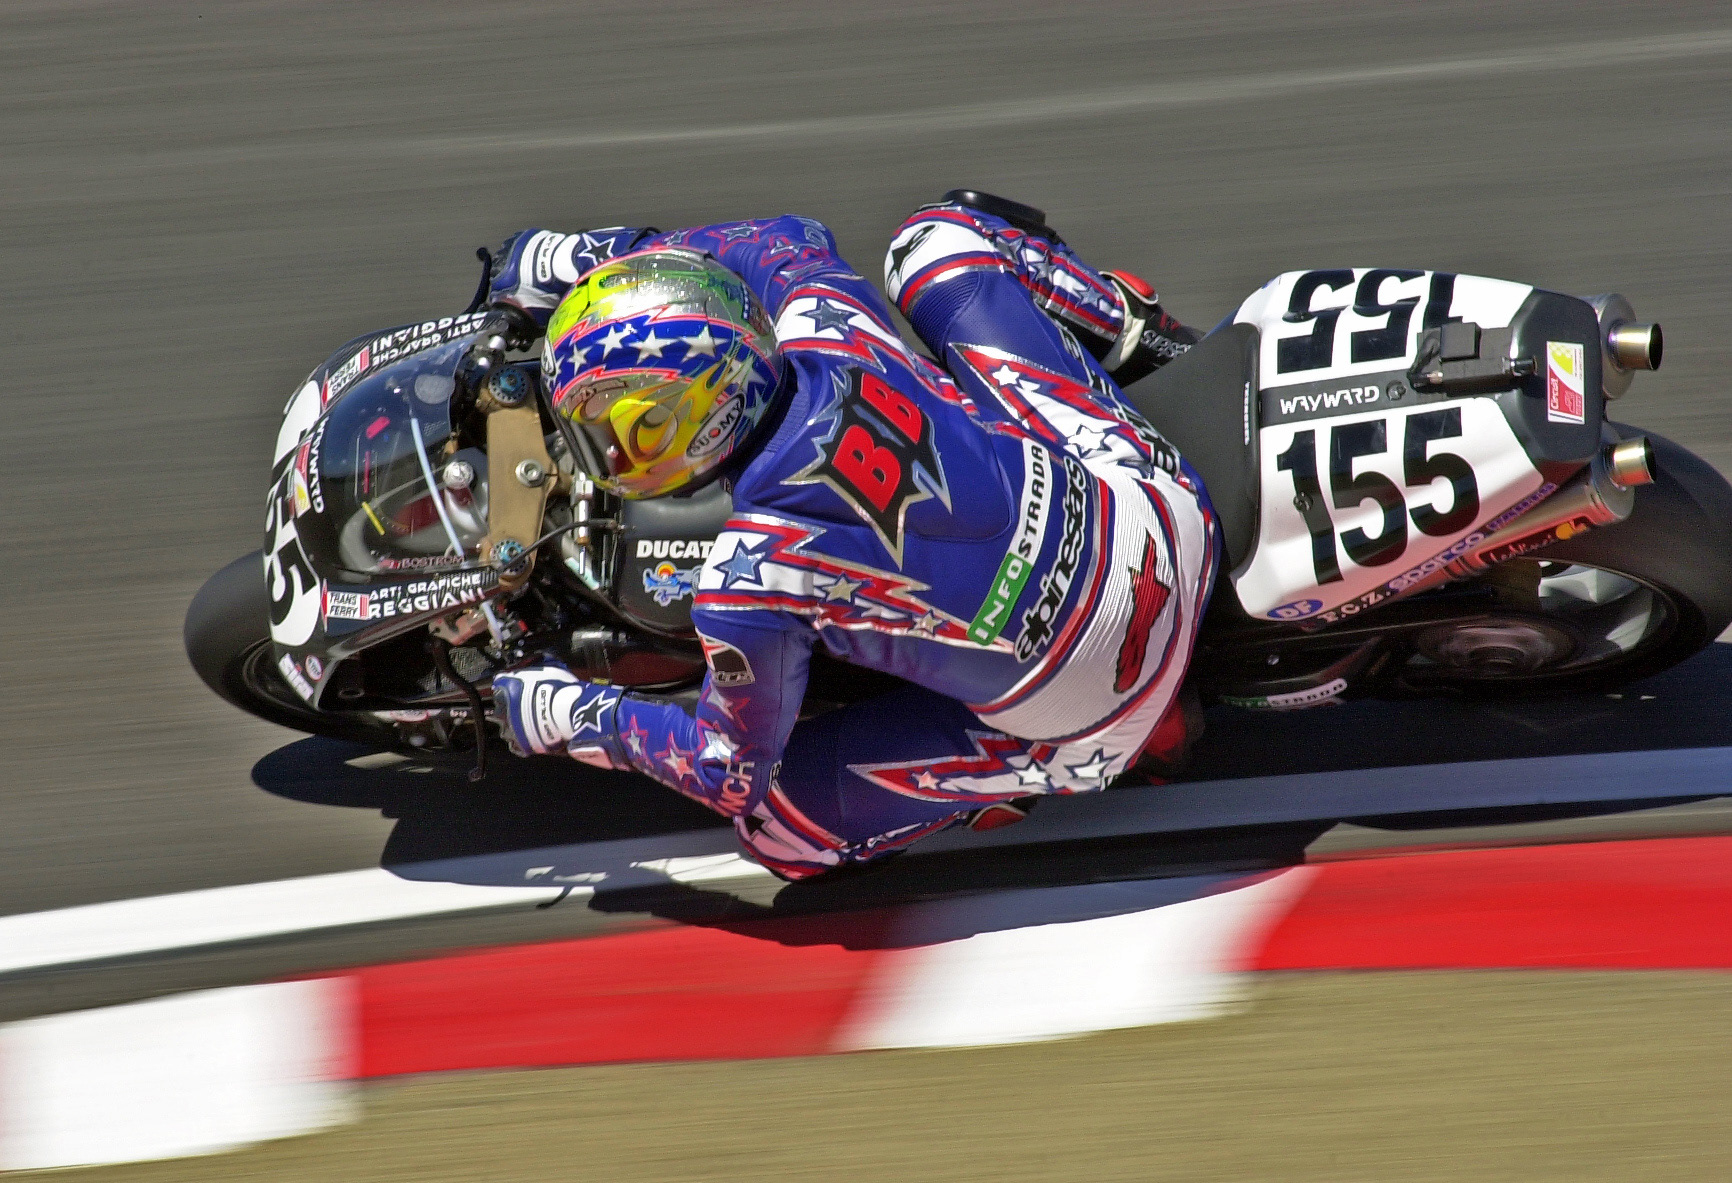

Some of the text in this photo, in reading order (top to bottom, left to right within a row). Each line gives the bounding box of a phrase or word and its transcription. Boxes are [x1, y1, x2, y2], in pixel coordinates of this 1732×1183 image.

[1280, 385, 1380, 415] WAYWARD
[1277, 406, 1480, 586] 155
[636, 540, 714, 559] DUCAT
[974, 443, 1044, 640] INFOSTRADA
[369, 573, 481, 601] ARTI GRAFICHE
[369, 586, 486, 620] REGGIANI
